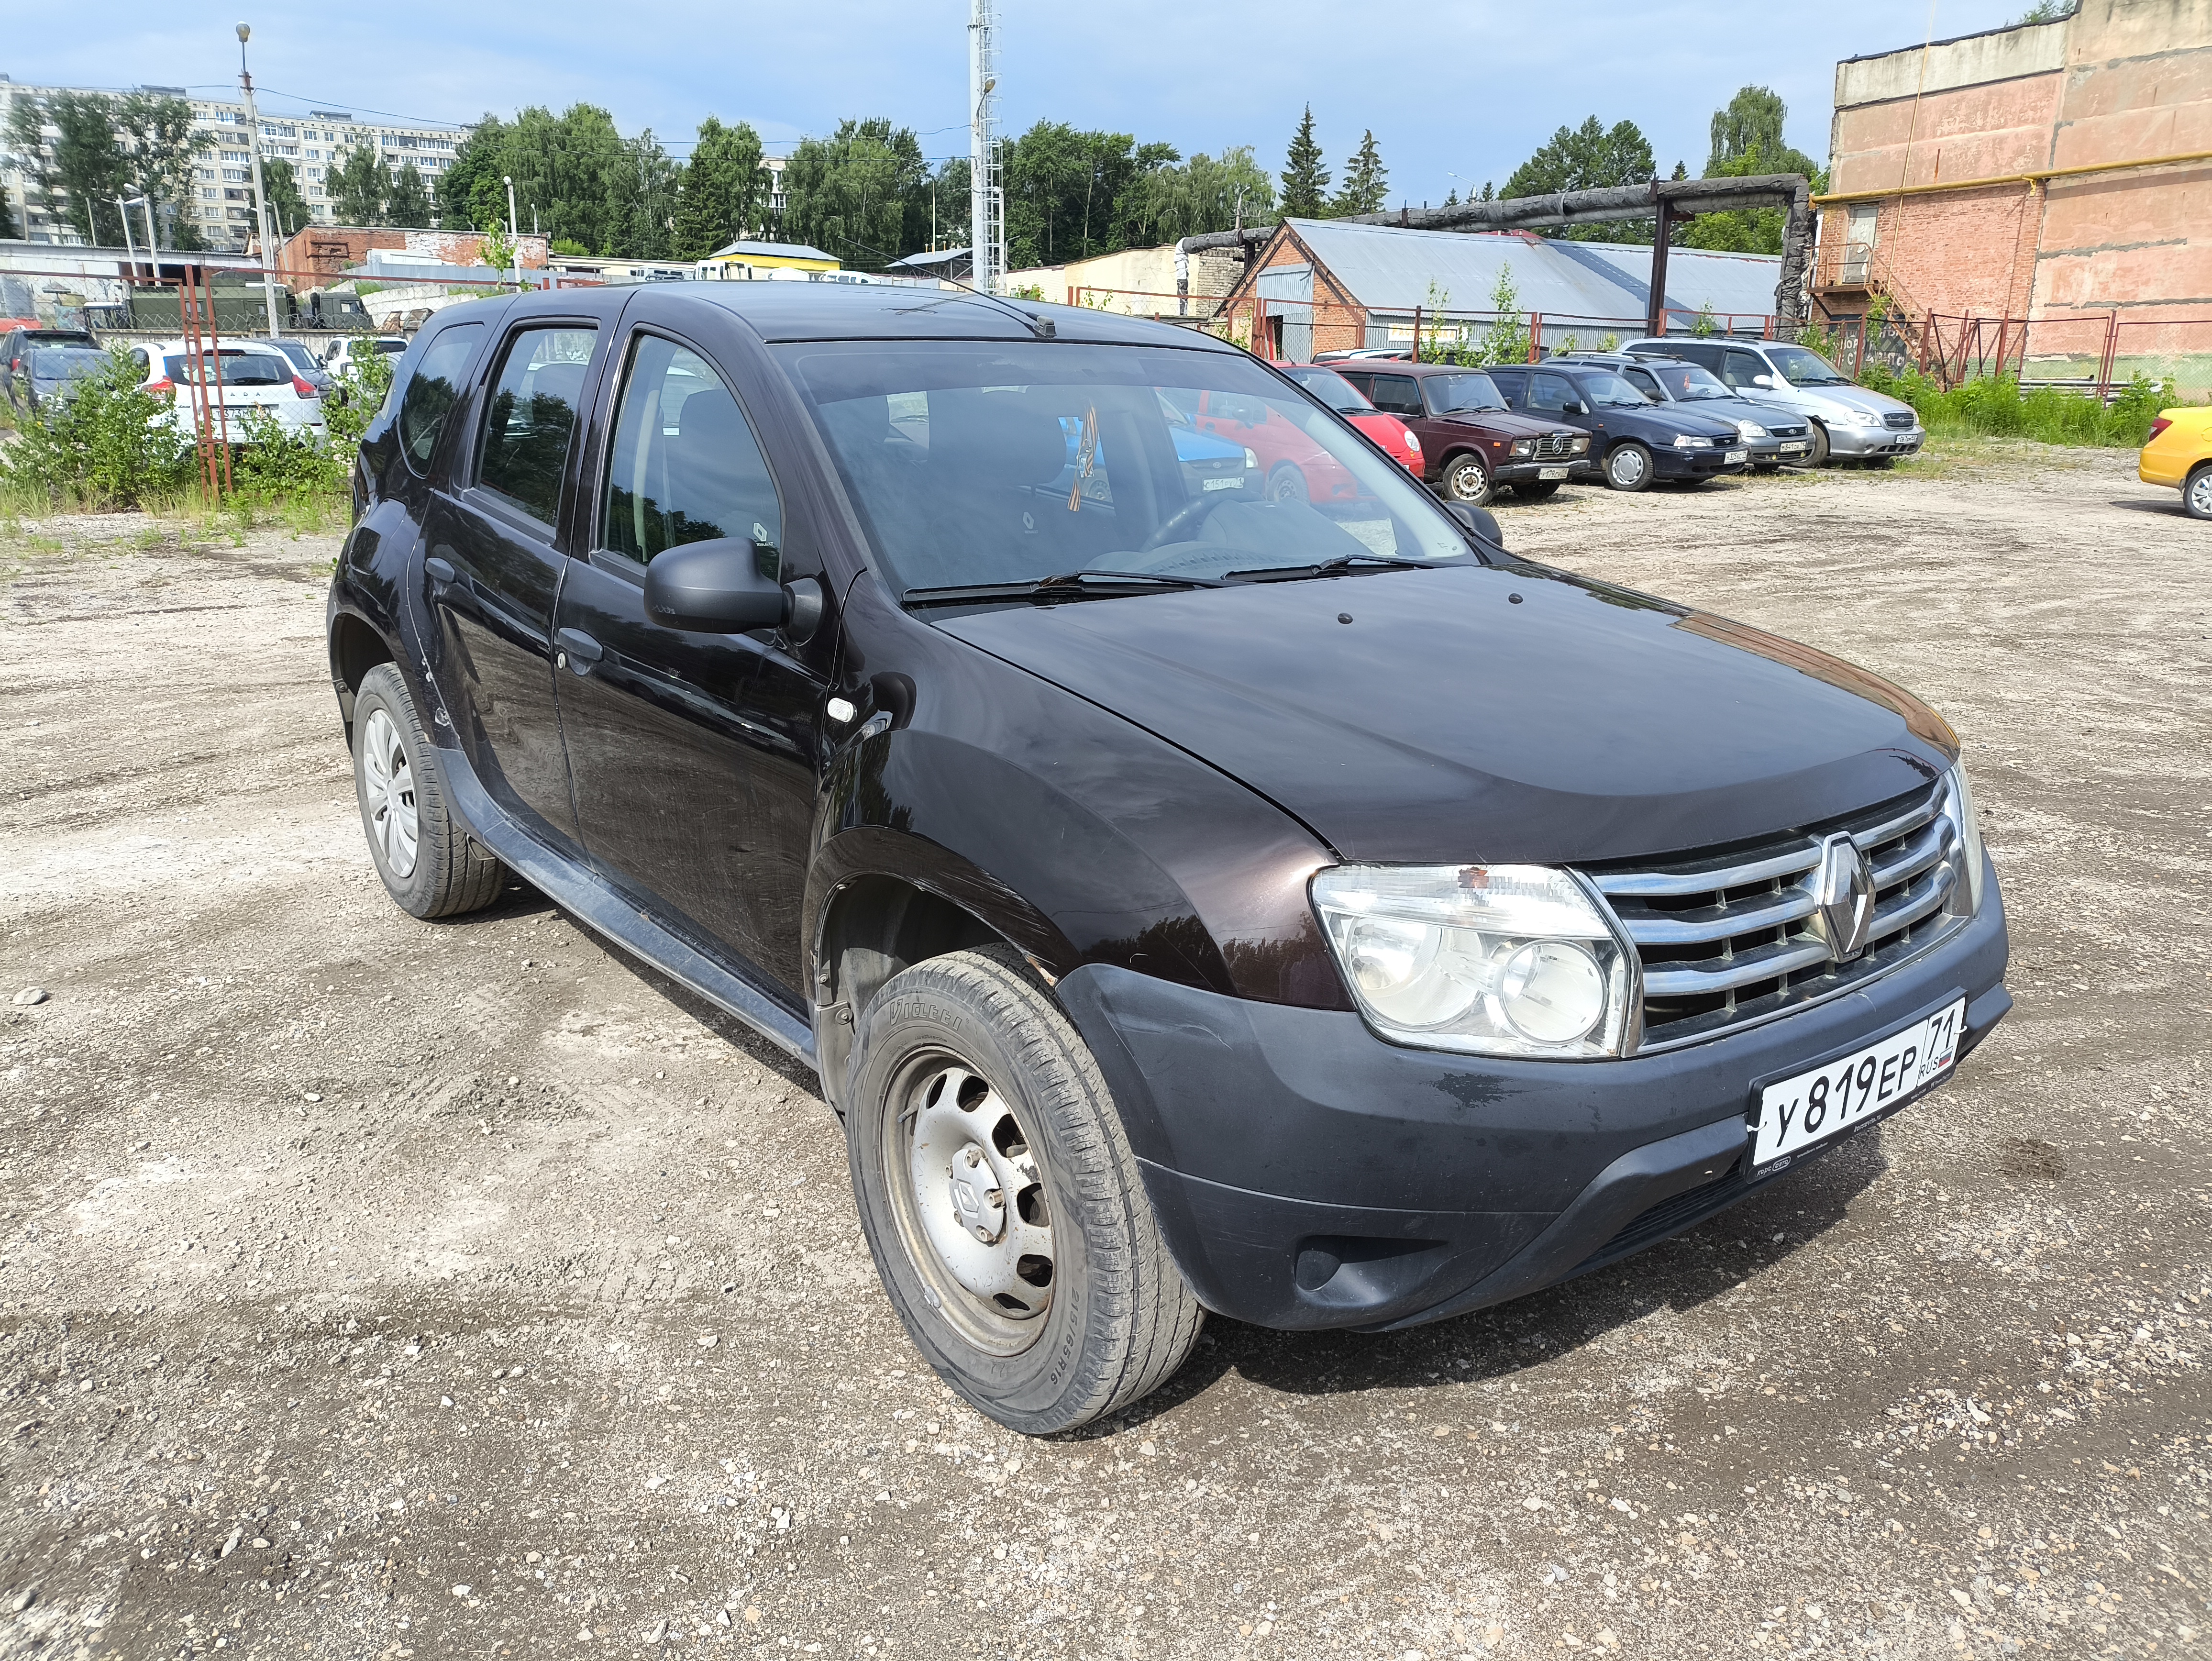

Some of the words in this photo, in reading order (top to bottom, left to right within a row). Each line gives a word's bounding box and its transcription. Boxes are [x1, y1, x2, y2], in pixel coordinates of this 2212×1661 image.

[215, 408, 255, 417] Т373М
[1776, 1045, 1917, 1148] У819ЕР
[1927, 1008, 1956, 1061] 71
[1919, 1056, 1939, 1080] RUS
[1051, 1286, 1080, 1385] 215/65R16
